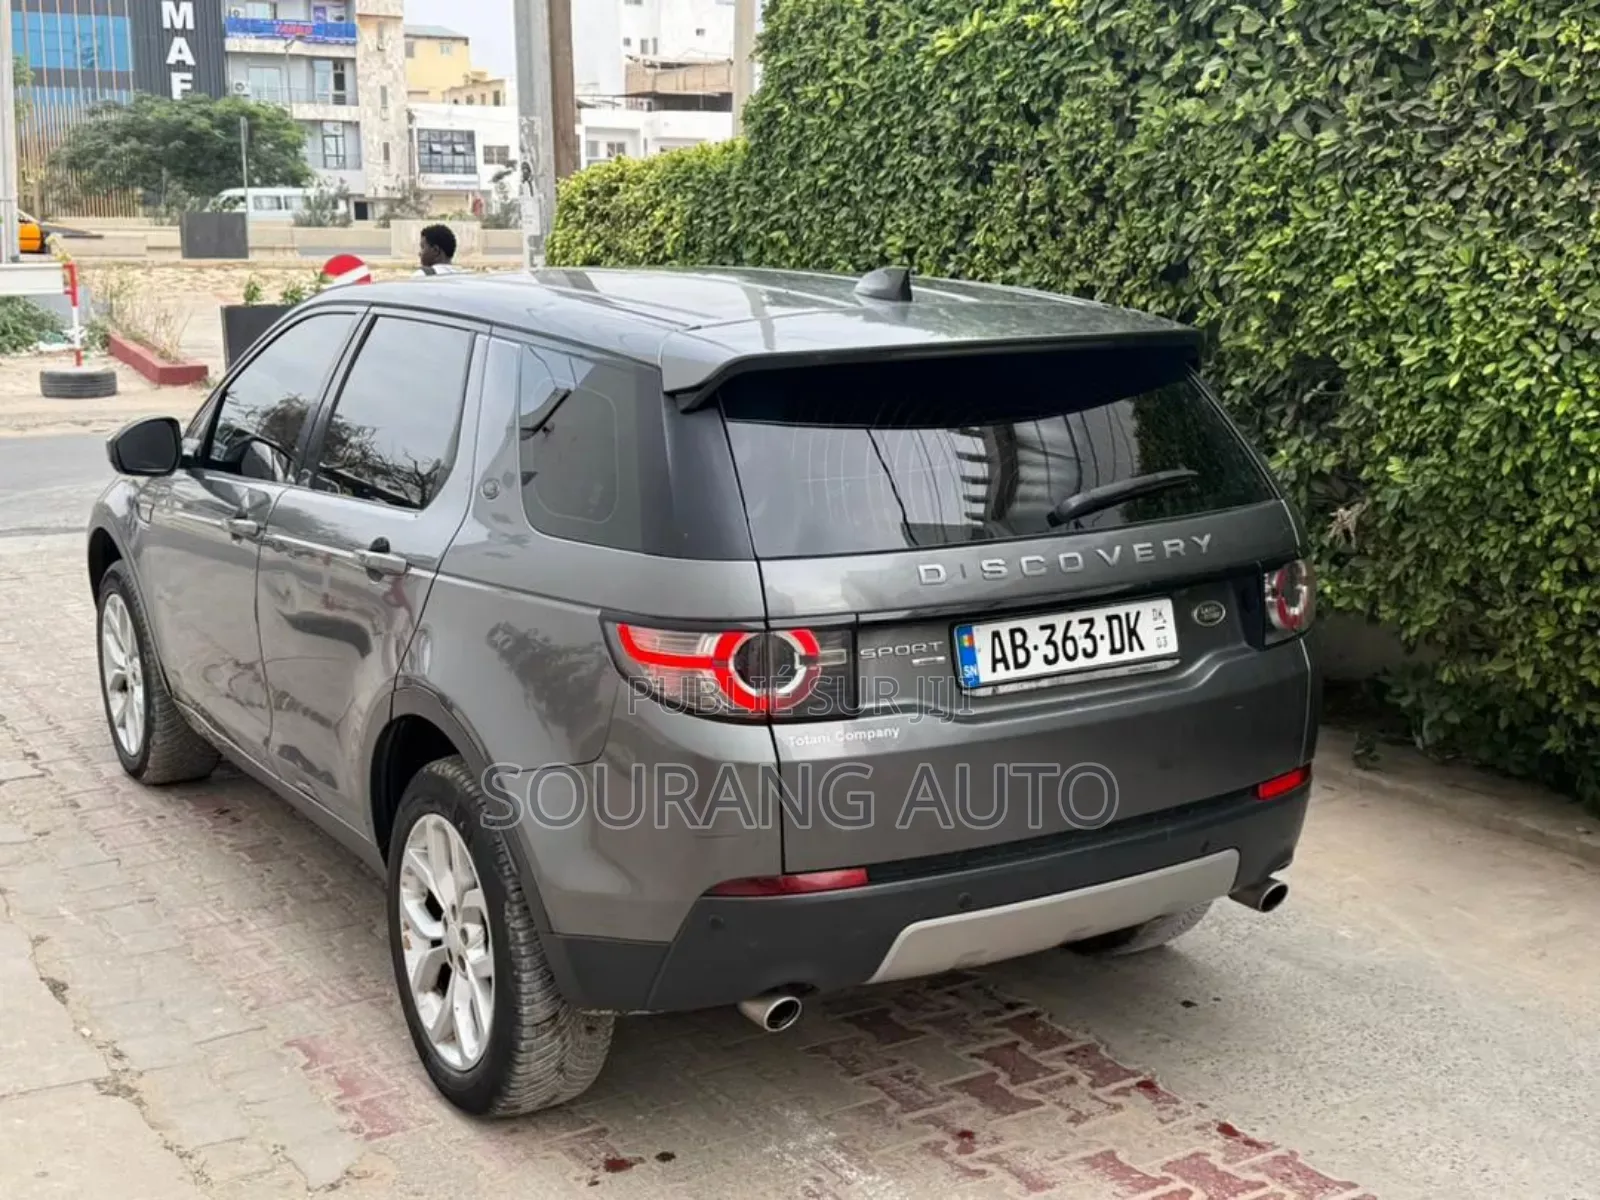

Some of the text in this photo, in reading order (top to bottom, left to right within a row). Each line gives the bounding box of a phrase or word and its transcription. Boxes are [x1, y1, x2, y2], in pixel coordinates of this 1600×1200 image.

[918, 533, 1212, 586] DISCOVERY
[860, 641, 944, 660] SPORT
[962, 664, 980, 680] SN
[834, 726, 900, 742] Company
